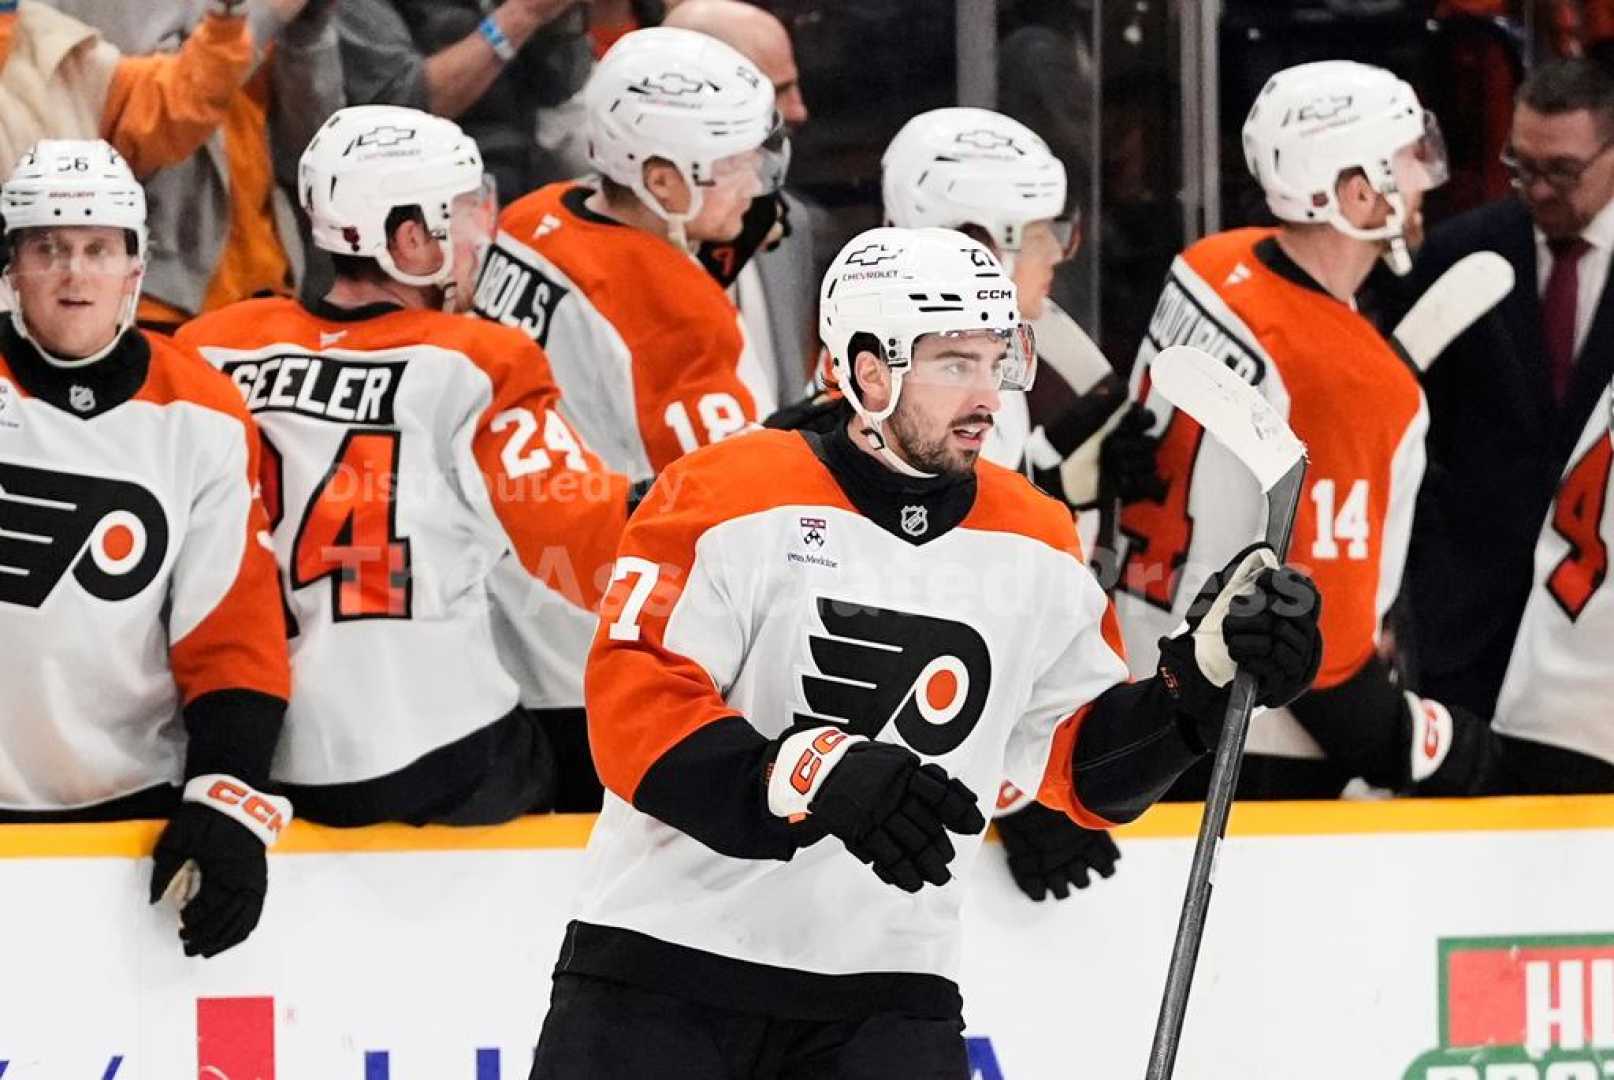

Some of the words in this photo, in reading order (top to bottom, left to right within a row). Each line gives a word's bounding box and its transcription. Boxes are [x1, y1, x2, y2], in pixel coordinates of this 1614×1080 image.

[976, 289, 1012, 300] CCM
[231, 358, 392, 421] SEELER
[490, 407, 589, 480] 24
[664, 393, 747, 454] 18
[1311, 478, 1370, 560] 14
